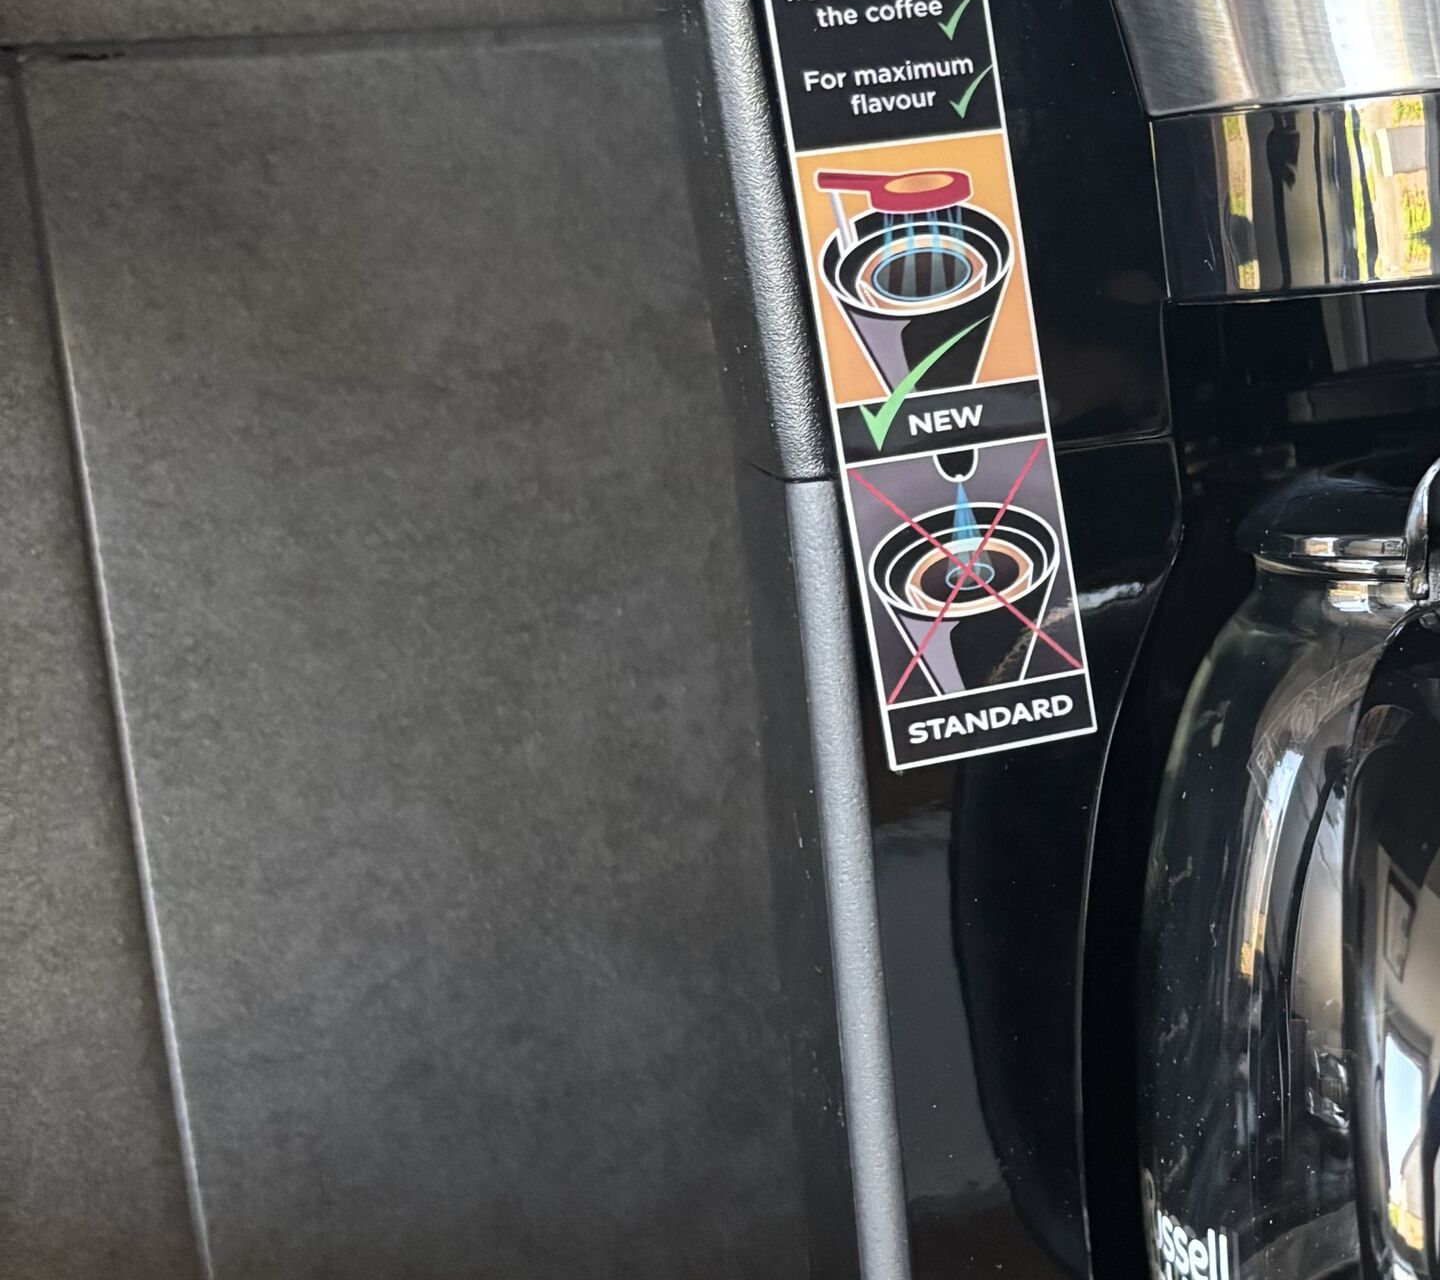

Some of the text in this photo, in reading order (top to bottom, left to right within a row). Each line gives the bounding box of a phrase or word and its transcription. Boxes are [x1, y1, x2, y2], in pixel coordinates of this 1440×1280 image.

[816, 4, 858, 28] the
[803, 56, 974, 93] For maximum
[850, 88, 937, 117] flavour
[908, 404, 983, 437] NEW
[907, 694, 1074, 745] STANDARD
